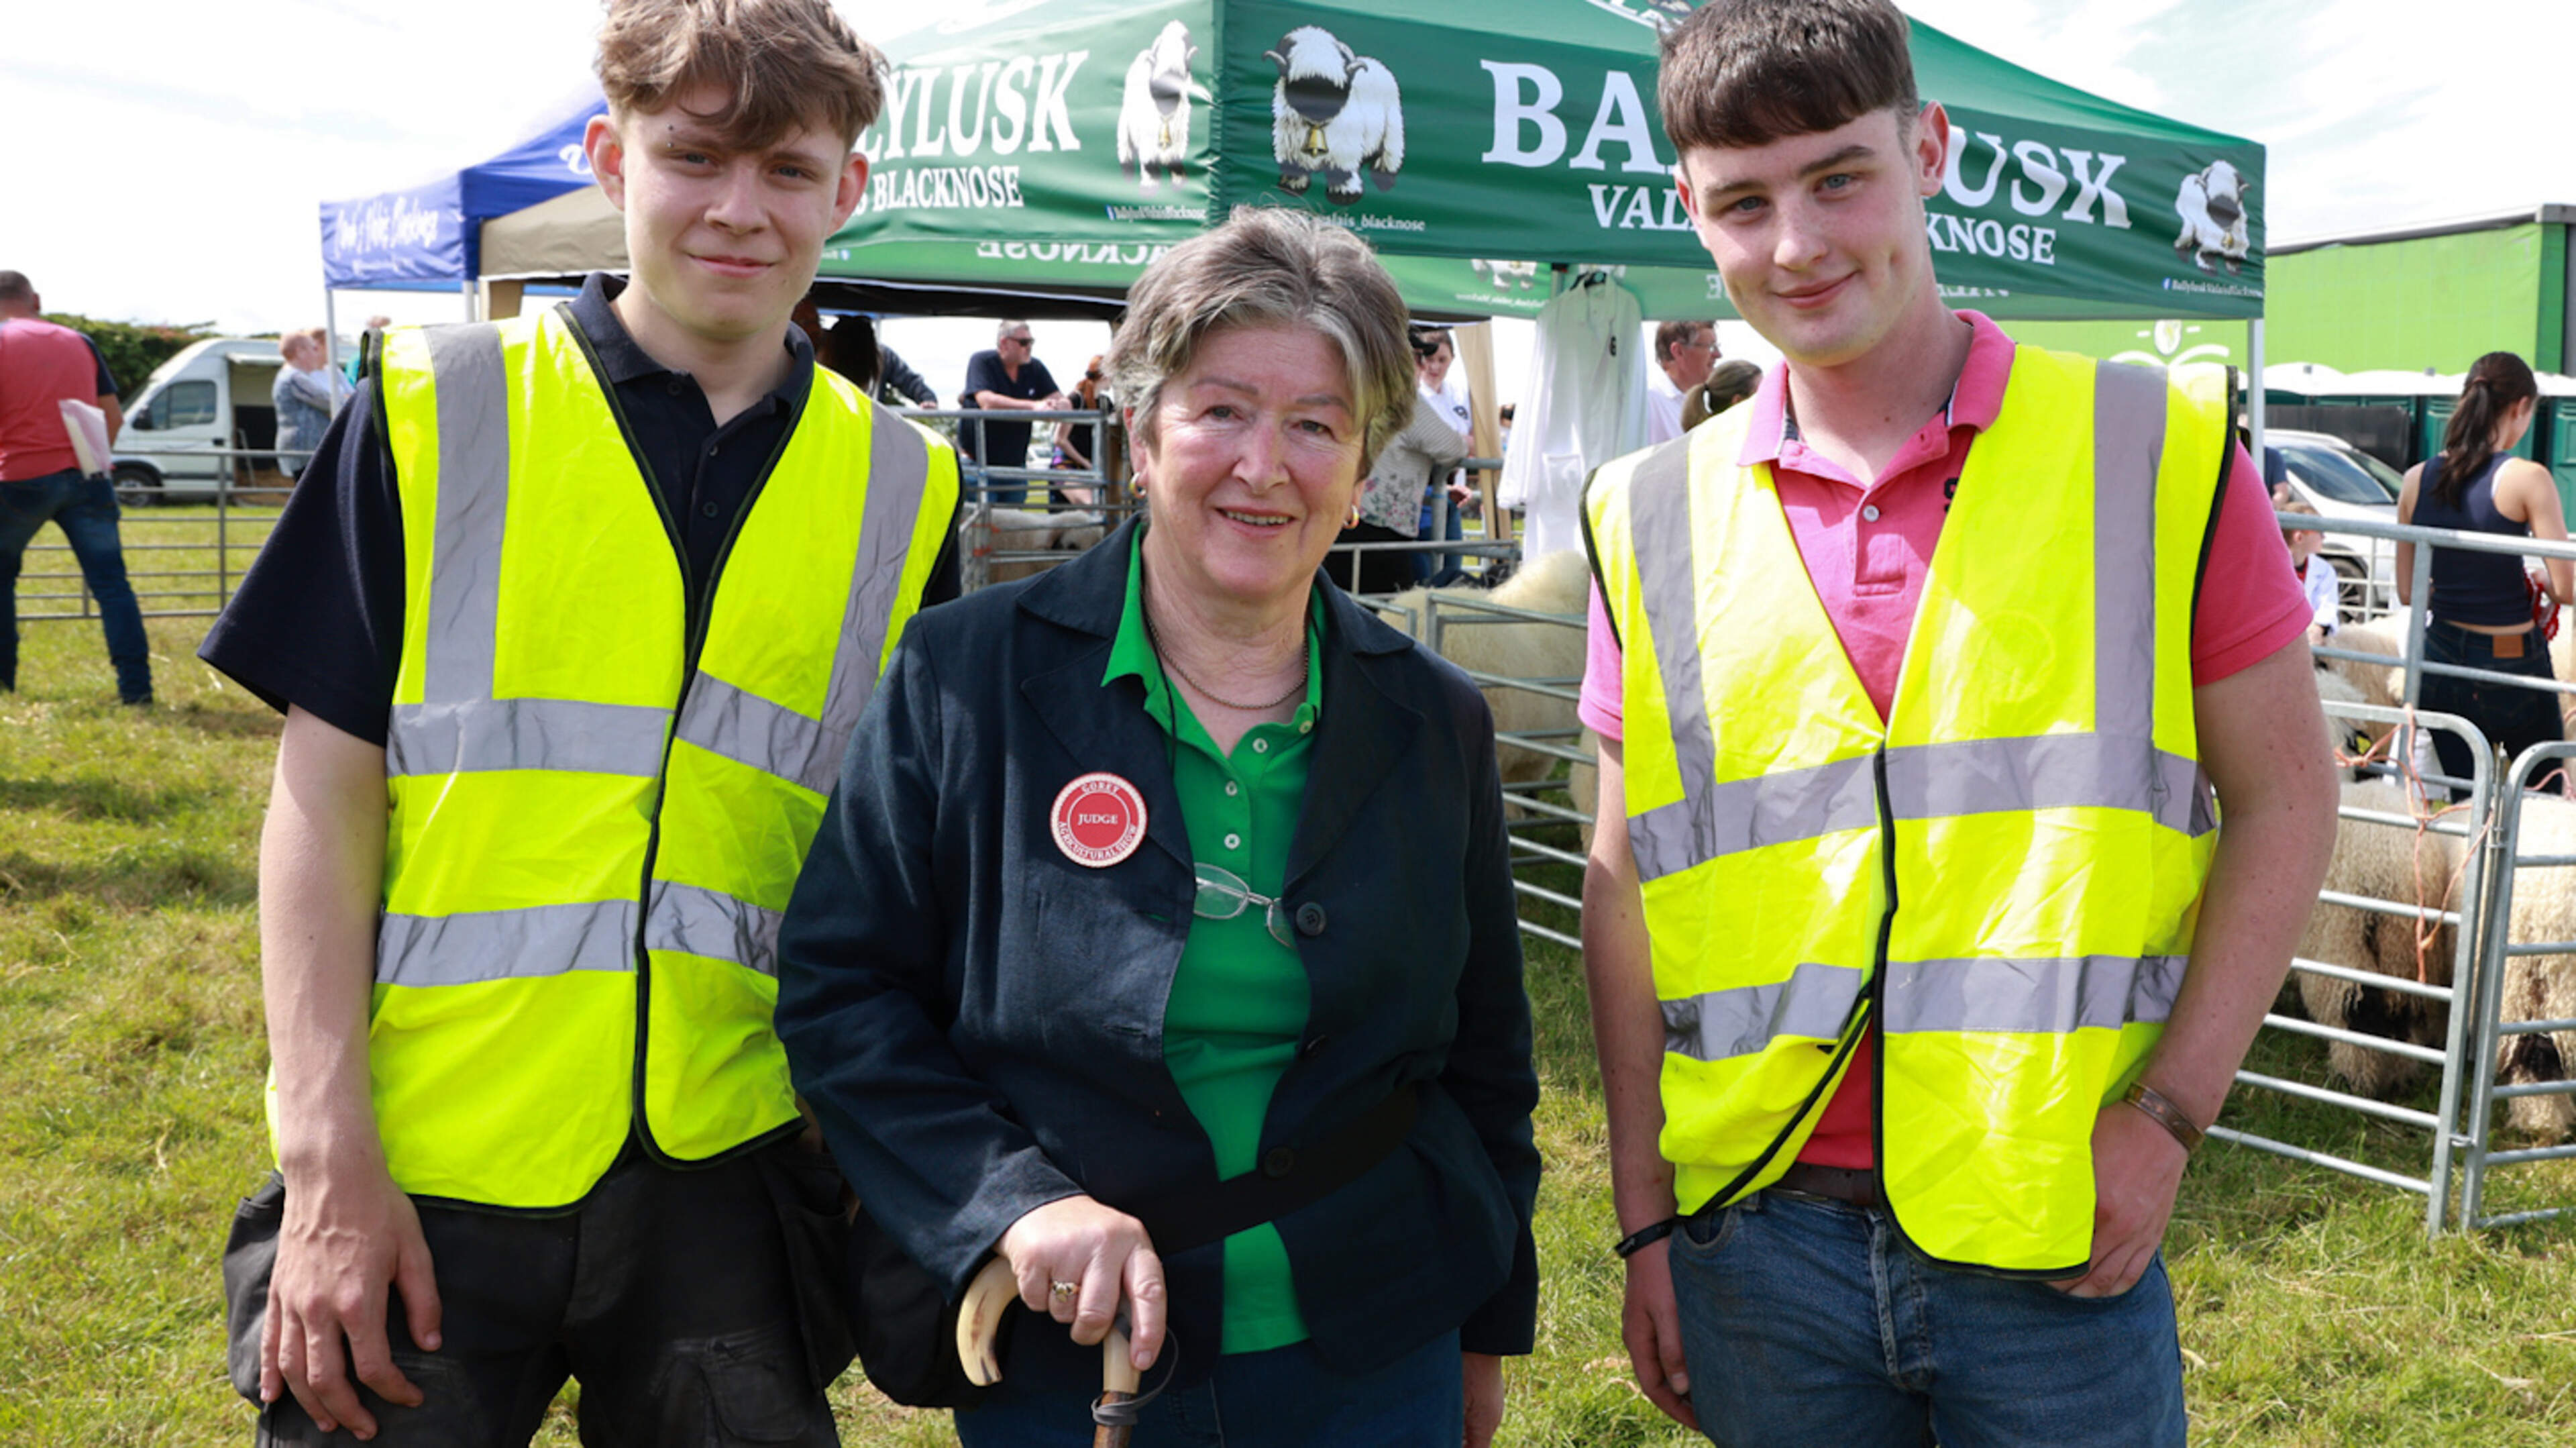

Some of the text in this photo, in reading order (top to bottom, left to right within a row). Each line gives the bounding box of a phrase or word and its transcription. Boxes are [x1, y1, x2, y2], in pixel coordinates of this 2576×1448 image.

[850, 49, 1089, 164] YLUSK
[872, 166, 1024, 212] BLACKNOSE
[1077, 813, 1118, 825] JUDGE
